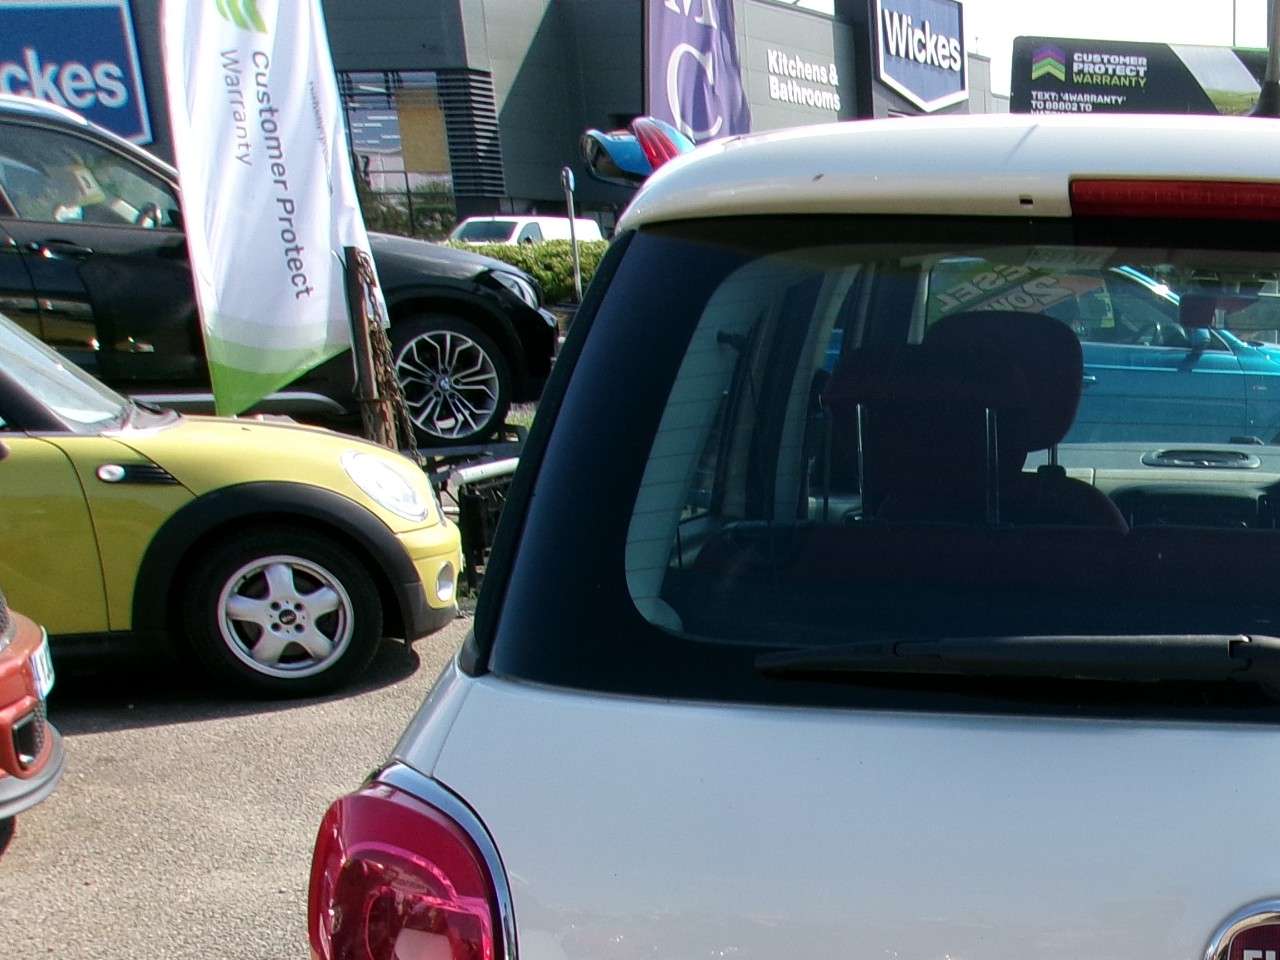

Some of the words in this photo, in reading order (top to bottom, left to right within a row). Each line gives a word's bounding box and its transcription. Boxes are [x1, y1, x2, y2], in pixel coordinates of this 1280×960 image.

[883, 8, 961, 71] Wickes
[767, 48, 827, 84] Kitchens
[829, 63, 839, 86] &
[1072, 61, 1147, 77] PROTECT
[1073, 52, 1147, 66] CUSTOMER
[768, 75, 841, 111] Bathrooms
[1072, 72, 1147, 87] WARRANTY
[220, 49, 252, 166] Warranty
[252, 51, 289, 191] Customer
[276, 198, 314, 299] Protect
